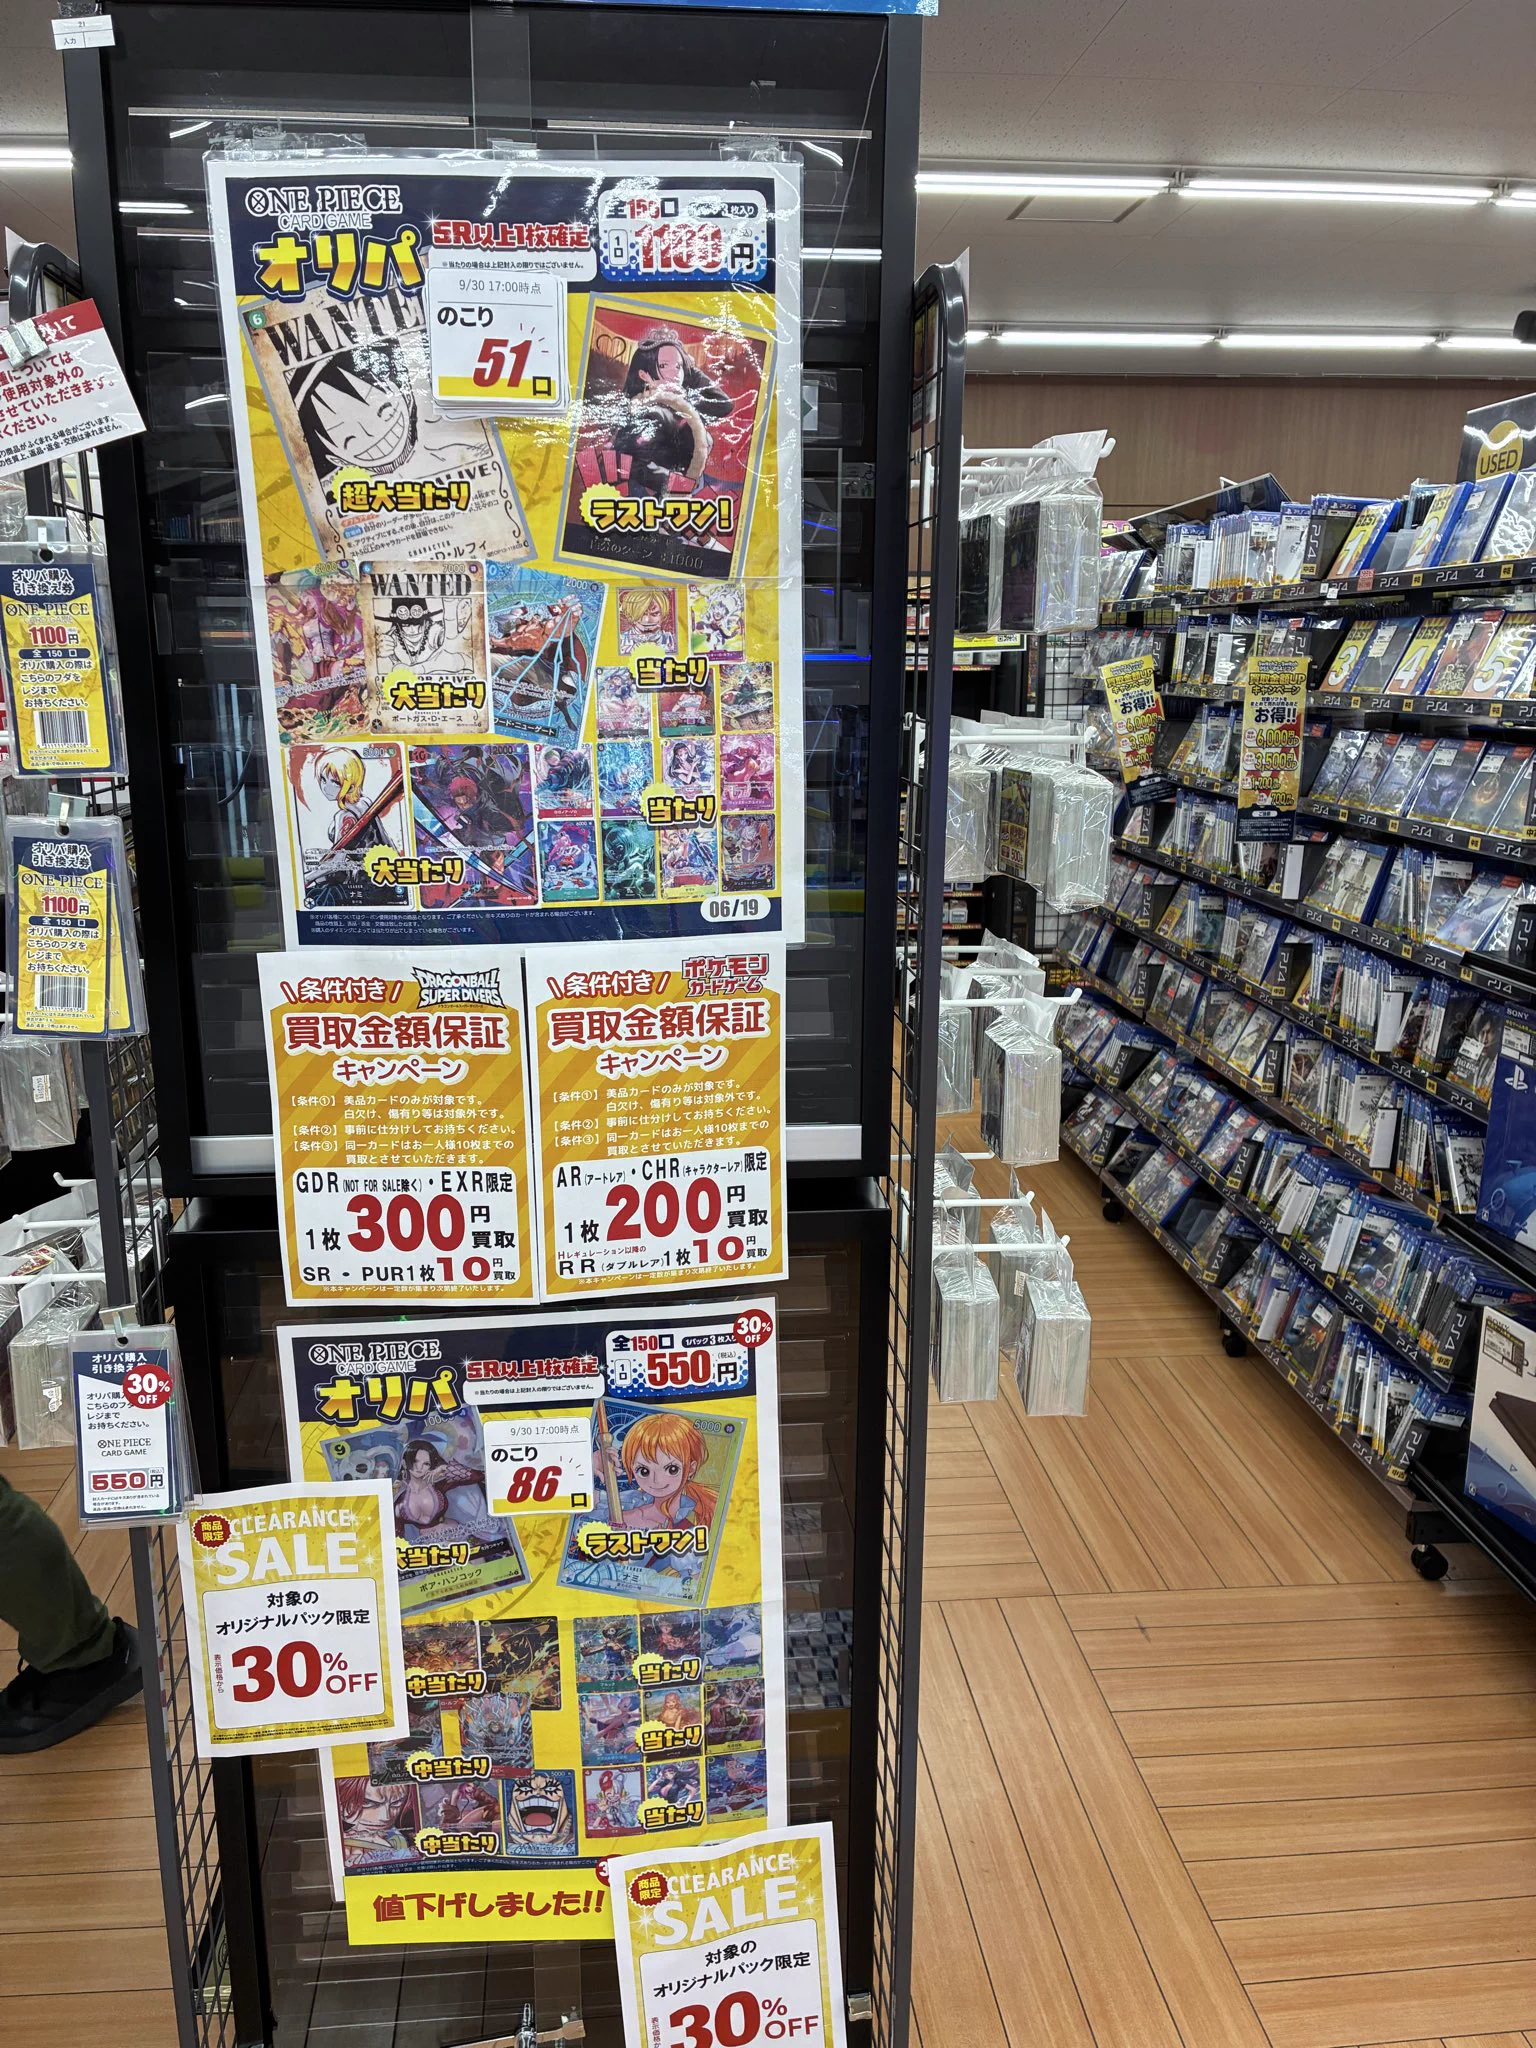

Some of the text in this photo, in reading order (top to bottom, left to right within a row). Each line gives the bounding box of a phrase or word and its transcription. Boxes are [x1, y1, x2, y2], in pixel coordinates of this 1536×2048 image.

[247, 185, 402, 216] ONE PIECE
[279, 213, 372, 229] CARD GAME
[433, 221, 590, 251] SR以上1枚確定
[255, 228, 425, 295] オリパ
[730, 243, 755, 272] 円
[459, 279, 541, 295] 9/30 17:00時点
[437, 306, 494, 327] のこり
[473, 338, 532, 389] 51
[0, 365, 84, 404] 使用対象外の
[1480, 449, 1519, 476] USED
[340, 481, 471, 512] 超大当たり
[1306, 524, 1322, 560] PS4
[12, 569, 74, 583] オリパ購入
[370, 573, 472, 598] WANTED
[14, 582, 75, 596] 引き換え券
[5, 602, 90, 617] ONE PIECE
[1348, 628, 1370, 641] BEST
[1416, 626, 1445, 640] BEST
[20, 660, 92, 671] オリパ購入の際は
[637, 658, 708, 688] 当たり
[1328, 646, 1358, 687] 3
[1394, 645, 1429, 690] 4
[21, 673, 81, 684] こちらのフダを
[1112, 679, 1153, 694] キャンペーン
[1249, 673, 1307, 686] 買取金額UP
[22, 686, 57, 696] レジまで
[391, 682, 486, 710] 大当たり
[1252, 685, 1301, 695] キャンペーン
[24, 698, 90, 709] お持ちください。
[647, 796, 716, 825] 当たり
[32, 843, 92, 857] オリパ購入
[32, 855, 92, 868] 引き換え券
[372, 858, 465, 885] 大当たり
[22, 874, 103, 889] ONE PIECE
[708, 899, 759, 919] 06/19
[27, 928, 99, 939] オリパ購入の際は
[27, 940, 87, 950] こちらのフダを
[27, 951, 61, 961] レジまで
[683, 955, 769, 978] ポケモン
[27, 963, 92, 974] お持ちください。
[421, 968, 499, 989] DRAGONBALL
[300, 979, 387, 1002] 条件付き
[566, 971, 654, 996] 条件付き
[688, 977, 764, 996] カードゲーム
[420, 988, 502, 1008] SUPER DIVERS
[551, 1001, 766, 1046] 買取金額保証
[1506, 1007, 1530, 1020] SONY
[286, 1014, 506, 1051] 買取金額保証
[336, 1058, 462, 1082] キャンペーン
[600, 1048, 722, 1074] キャンペーン
[344, 1095, 483, 1106] 美品カードのみが対象です。
[606, 1080, 741, 1100] 美品カードのみが対象です。
[606, 1092, 761, 1113] 白欠け、傷有り等は対象外です。
[344, 1108, 505, 1120] 白欠け、傷有り等は対象外です。
[606, 1106, 772, 1128] 事前に仕分けしてお持ちください。
[345, 1124, 517, 1136] 事前に仕分けしてお持ちください。
[606, 1120, 769, 1143] 同一カードはお一人様10枚までの
[345, 1139, 515, 1151] 同一カードはお一人様10枚までの
[607, 1137, 742, 1157] 買取とさせていただきます。
[346, 1153, 486, 1165] 買取とさせていただきます。
[565, 1176, 746, 1245] 1枚 200 円
[727, 1208, 768, 1228] 買取
[305, 1193, 491, 1254] 1枚 300 円
[471, 1230, 516, 1249] 買取
[558, 1244, 647, 1260] Hレギュレーション以降の
[737, 1316, 772, 1336] 30%
[612, 1333, 675, 1352] 全150口
[744, 1334, 761, 1344] OFF
[92, 1353, 148, 1364] オリパ購入
[309, 1340, 441, 1365] ONE PIECE
[337, 1360, 416, 1375] CARD GAME
[467, 1356, 599, 1379] SR以上1枚確定
[648, 1349, 738, 1387] 550 円
[127, 1373, 170, 1394] 30%
[137, 1395, 158, 1405] OFF
[318, 1368, 460, 1421] オリパ
[87, 1412, 120, 1420] レジまで
[87, 1421, 150, 1430] お持ちください。
[511, 1424, 579, 1436] 9/30 17:00時点
[97, 1437, 152, 1449] ONE PIECE
[491, 1446, 538, 1463] のこり
[92, 1472, 164, 1491] 550円
[506, 1465, 562, 1504] 86
[201, 1520, 223, 1532] 商品
[230, 1508, 351, 1537] CLEARANCE
[202, 1531, 225, 1543] 限定
[216, 1532, 360, 1585] SALE
[419, 1568, 482, 1593] ボア・ハンコック
[266, 1590, 319, 1609] 対象の
[215, 1609, 371, 1636] オリジナルパック限定
[213, 1654, 225, 1695] 表示価格から
[326, 1672, 379, 1694] OFF
[639, 1660, 701, 1685] 当たり
[407, 1671, 486, 1696] 中当たり
[642, 1726, 702, 1751] 当たり
[412, 1756, 491, 1780] 中当たり
[645, 1802, 704, 1828] 当たり
[421, 1833, 497, 1856] 中当たり
[637, 1877, 661, 1890] 商品
[668, 1853, 791, 1895] CLEARANCE
[639, 1888, 663, 1901] 限定
[653, 1875, 799, 1946] SALE
[704, 1940, 757, 1968] 対象の
[653, 1951, 812, 1998] オリジナルパック限定
[764, 2015, 819, 2040] OFF
